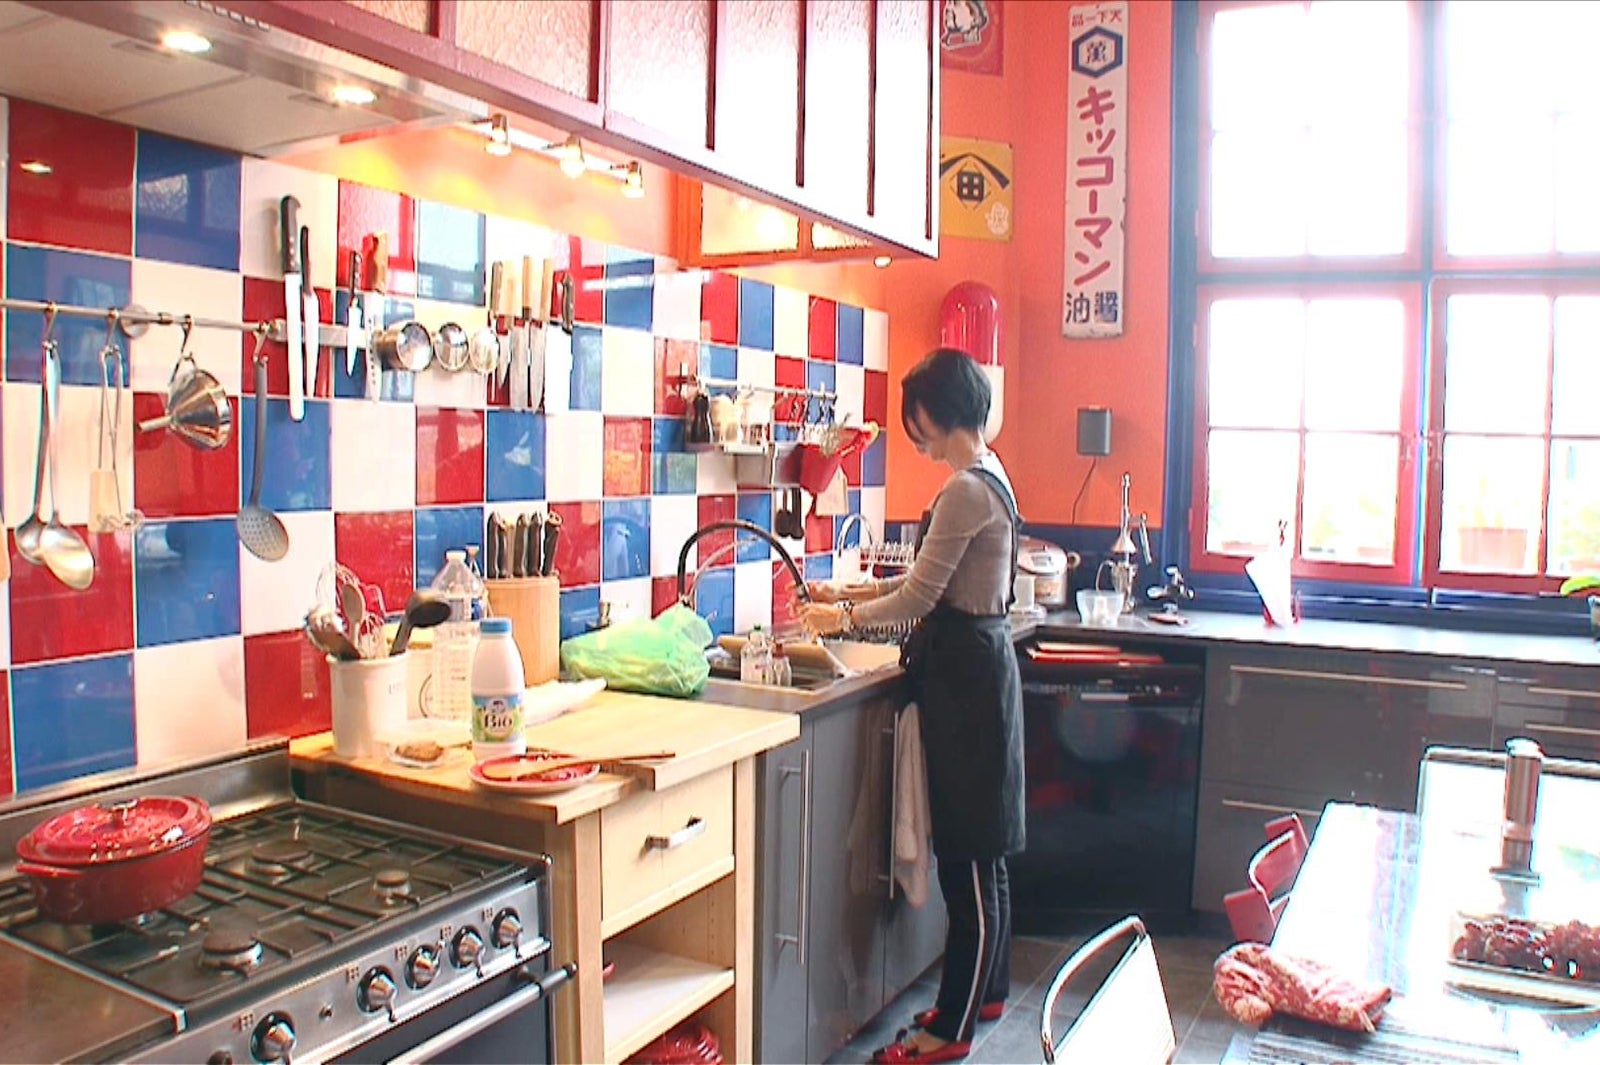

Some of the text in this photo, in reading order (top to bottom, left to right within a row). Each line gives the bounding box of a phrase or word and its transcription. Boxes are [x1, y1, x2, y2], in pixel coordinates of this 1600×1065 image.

[1073, 85, 1117, 286] キッコーマン
